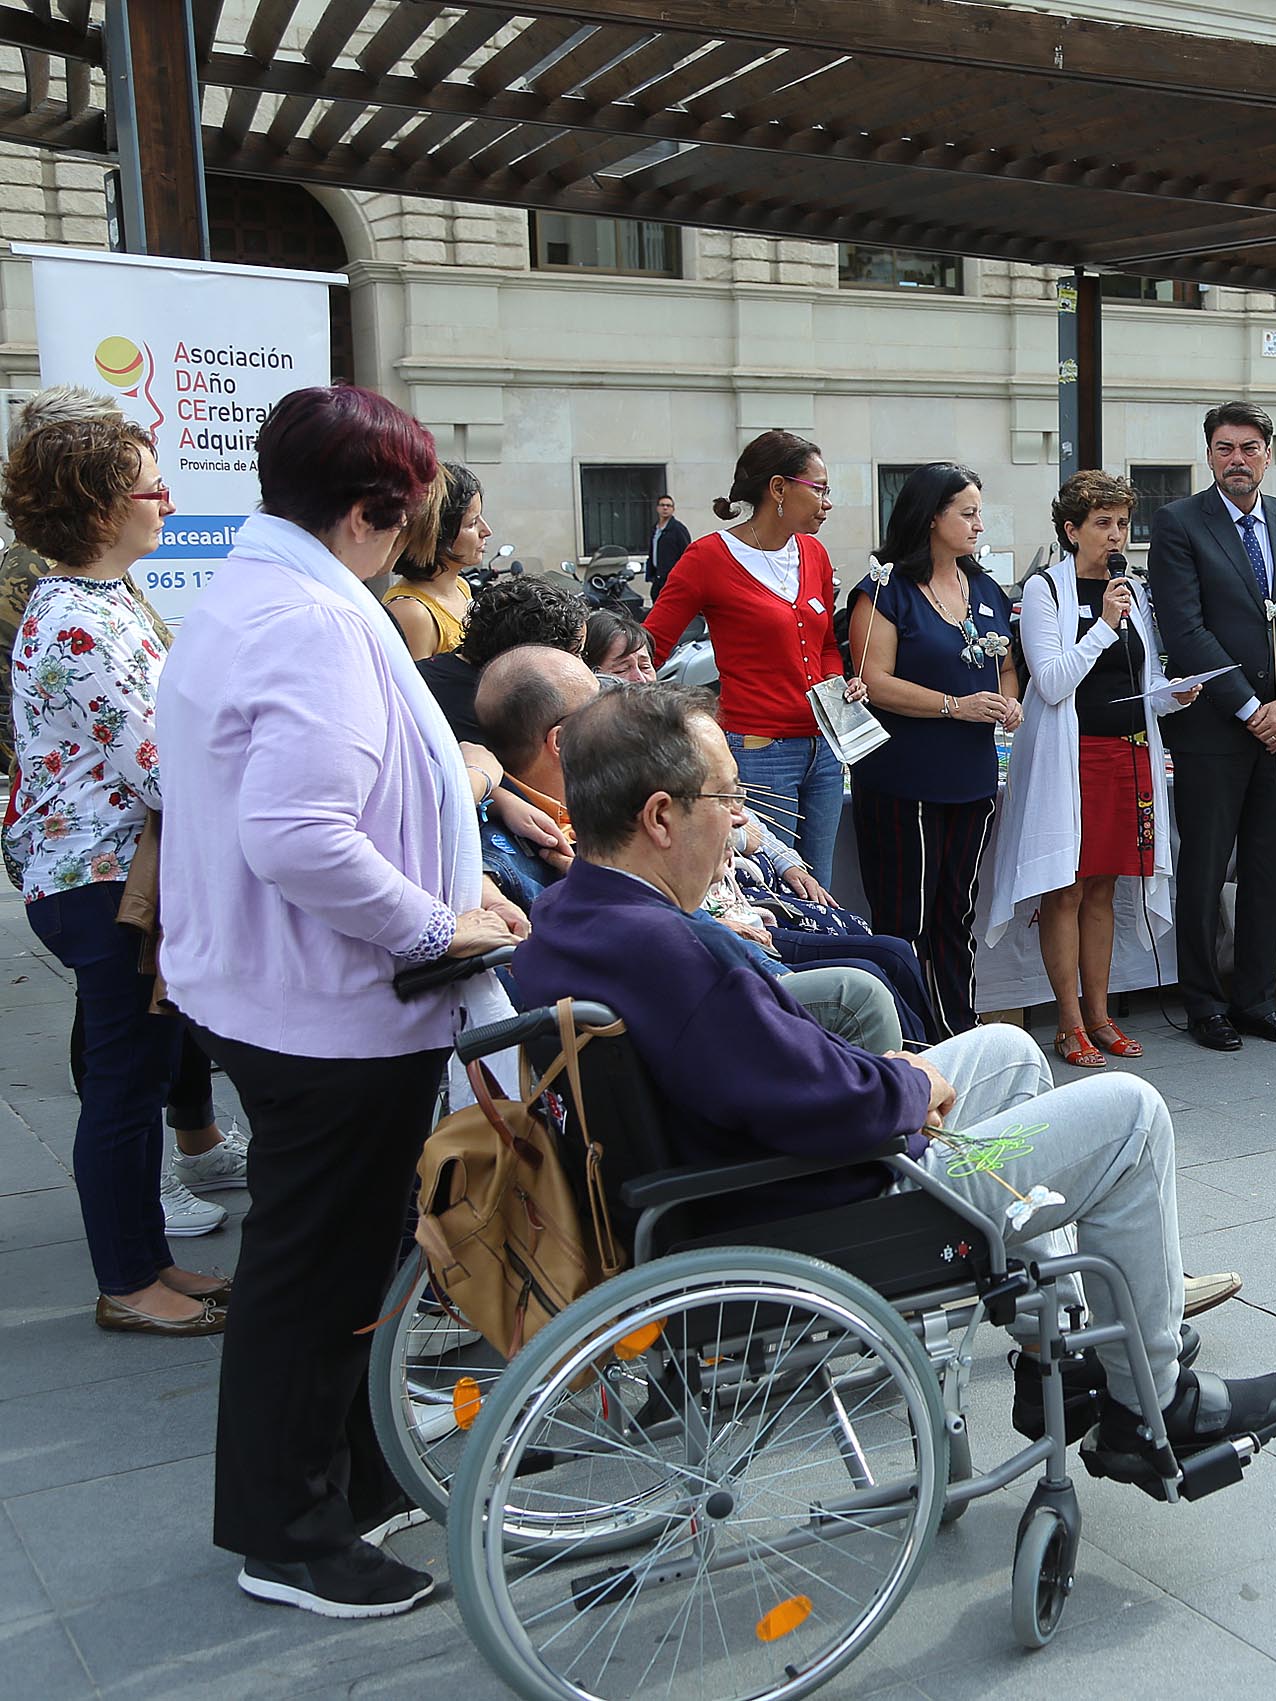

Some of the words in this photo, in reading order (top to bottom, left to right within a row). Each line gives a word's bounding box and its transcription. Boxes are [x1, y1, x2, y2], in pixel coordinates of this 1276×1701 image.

[173, 341, 294, 370] Asociación
[176, 369, 236, 395] DAño
[180, 458, 230, 470] Provincia
[234, 460, 247, 472] de
[146, 571, 186, 589] 965
